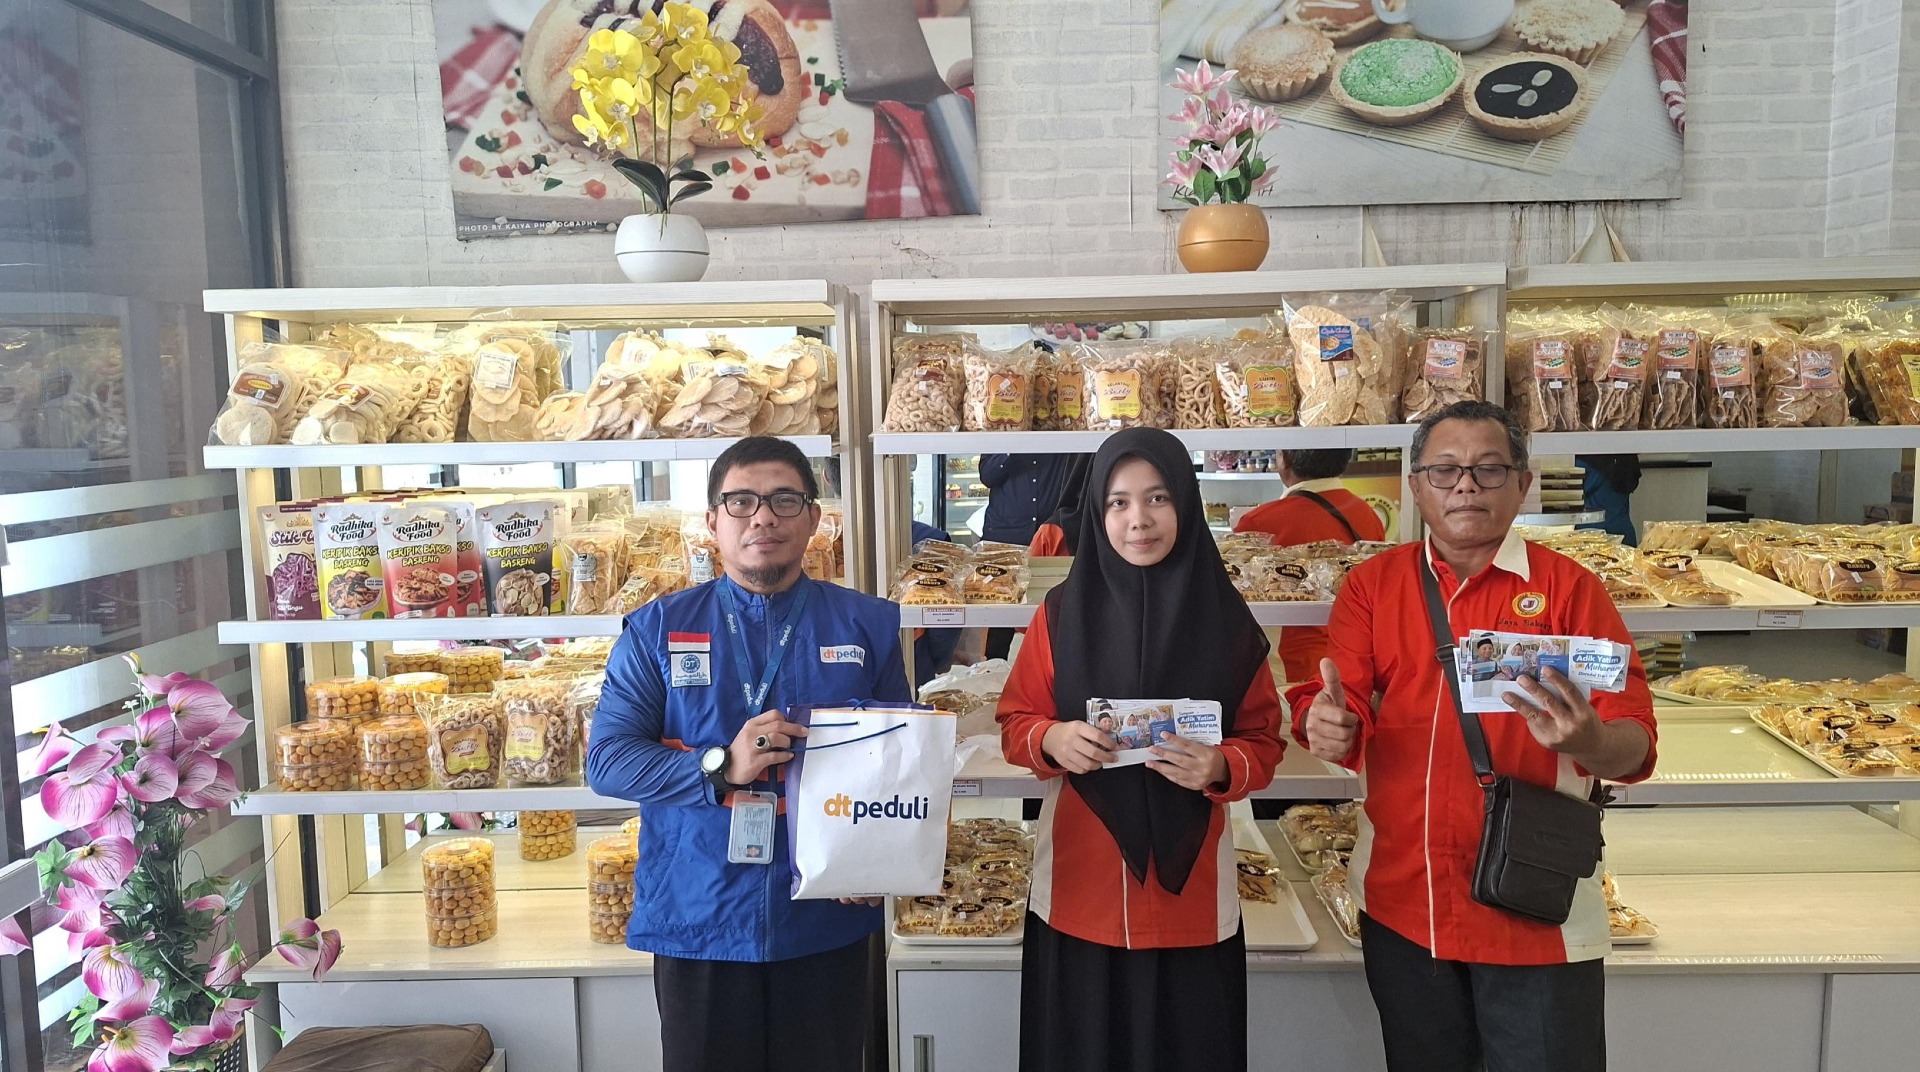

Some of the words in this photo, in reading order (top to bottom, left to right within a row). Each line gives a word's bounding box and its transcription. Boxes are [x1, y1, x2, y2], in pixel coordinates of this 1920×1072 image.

[458, 224, 488, 232] PHOTO
[505, 222, 531, 231] KAIYA
[534, 219, 598, 230] PHOTOGRAPHY
[331, 520, 373, 534] Radhika
[396, 520, 440, 535] Radhika
[496, 519, 539, 534] Radhika
[340, 530, 365, 541] Food
[407, 529, 433, 541] Food
[505, 529, 531, 541] Food
[322, 547, 352, 559] KERIPIK
[352, 546, 379, 557] BAKS
[387, 545, 421, 559] KERIPIK
[423, 543, 452, 555] BAKSO
[486, 545, 521, 558] KERIPIK
[521, 542, 548, 554] BAKSO
[334, 558, 370, 569] BASRENG
[402, 555, 440, 567] BASRENG
[500, 556, 536, 568] BASRENG
[1576, 654, 1596, 662] Adik
[1597, 655, 1619, 664] Yatim
[823, 792, 929, 825] dtpeduli
